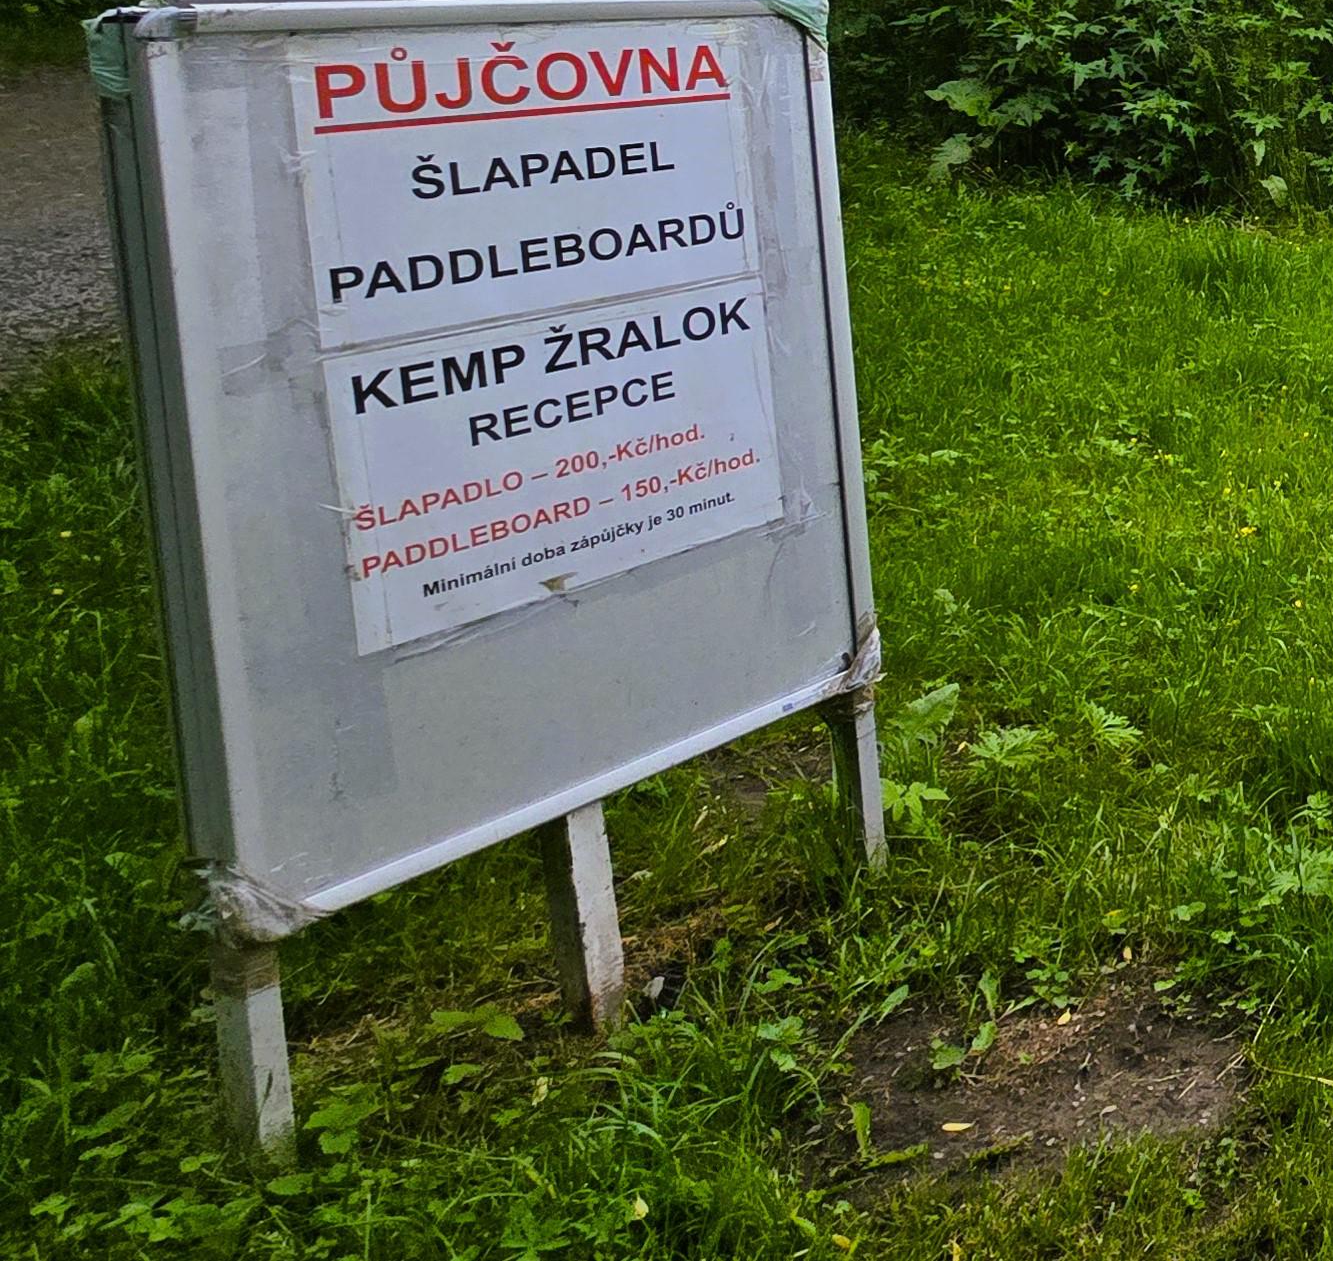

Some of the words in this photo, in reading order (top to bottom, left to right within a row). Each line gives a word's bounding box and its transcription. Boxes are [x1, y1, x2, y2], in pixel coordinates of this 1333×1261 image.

[314, 42, 728, 119] PŮJČOVNA
[410, 141, 675, 199] ŠLAPADEL
[329, 202, 745, 304] PADDLEBOARDŮ
[351, 343, 525, 414] KEMP
[543, 297, 751, 374] ŽRALOK
[467, 371, 676, 446] RECEPCE
[354, 471, 523, 531] ŠLAPADLO
[555, 423, 705, 478] 200,-Kč/hod.
[362, 496, 591, 579] PADDLEBOARD
[620, 448, 761, 503] 150,-Kč/hod.
[422, 557, 517, 597] Minimální
[521, 544, 566, 567] doba
[647, 515, 663, 530] je
[666, 506, 685, 522] 30
